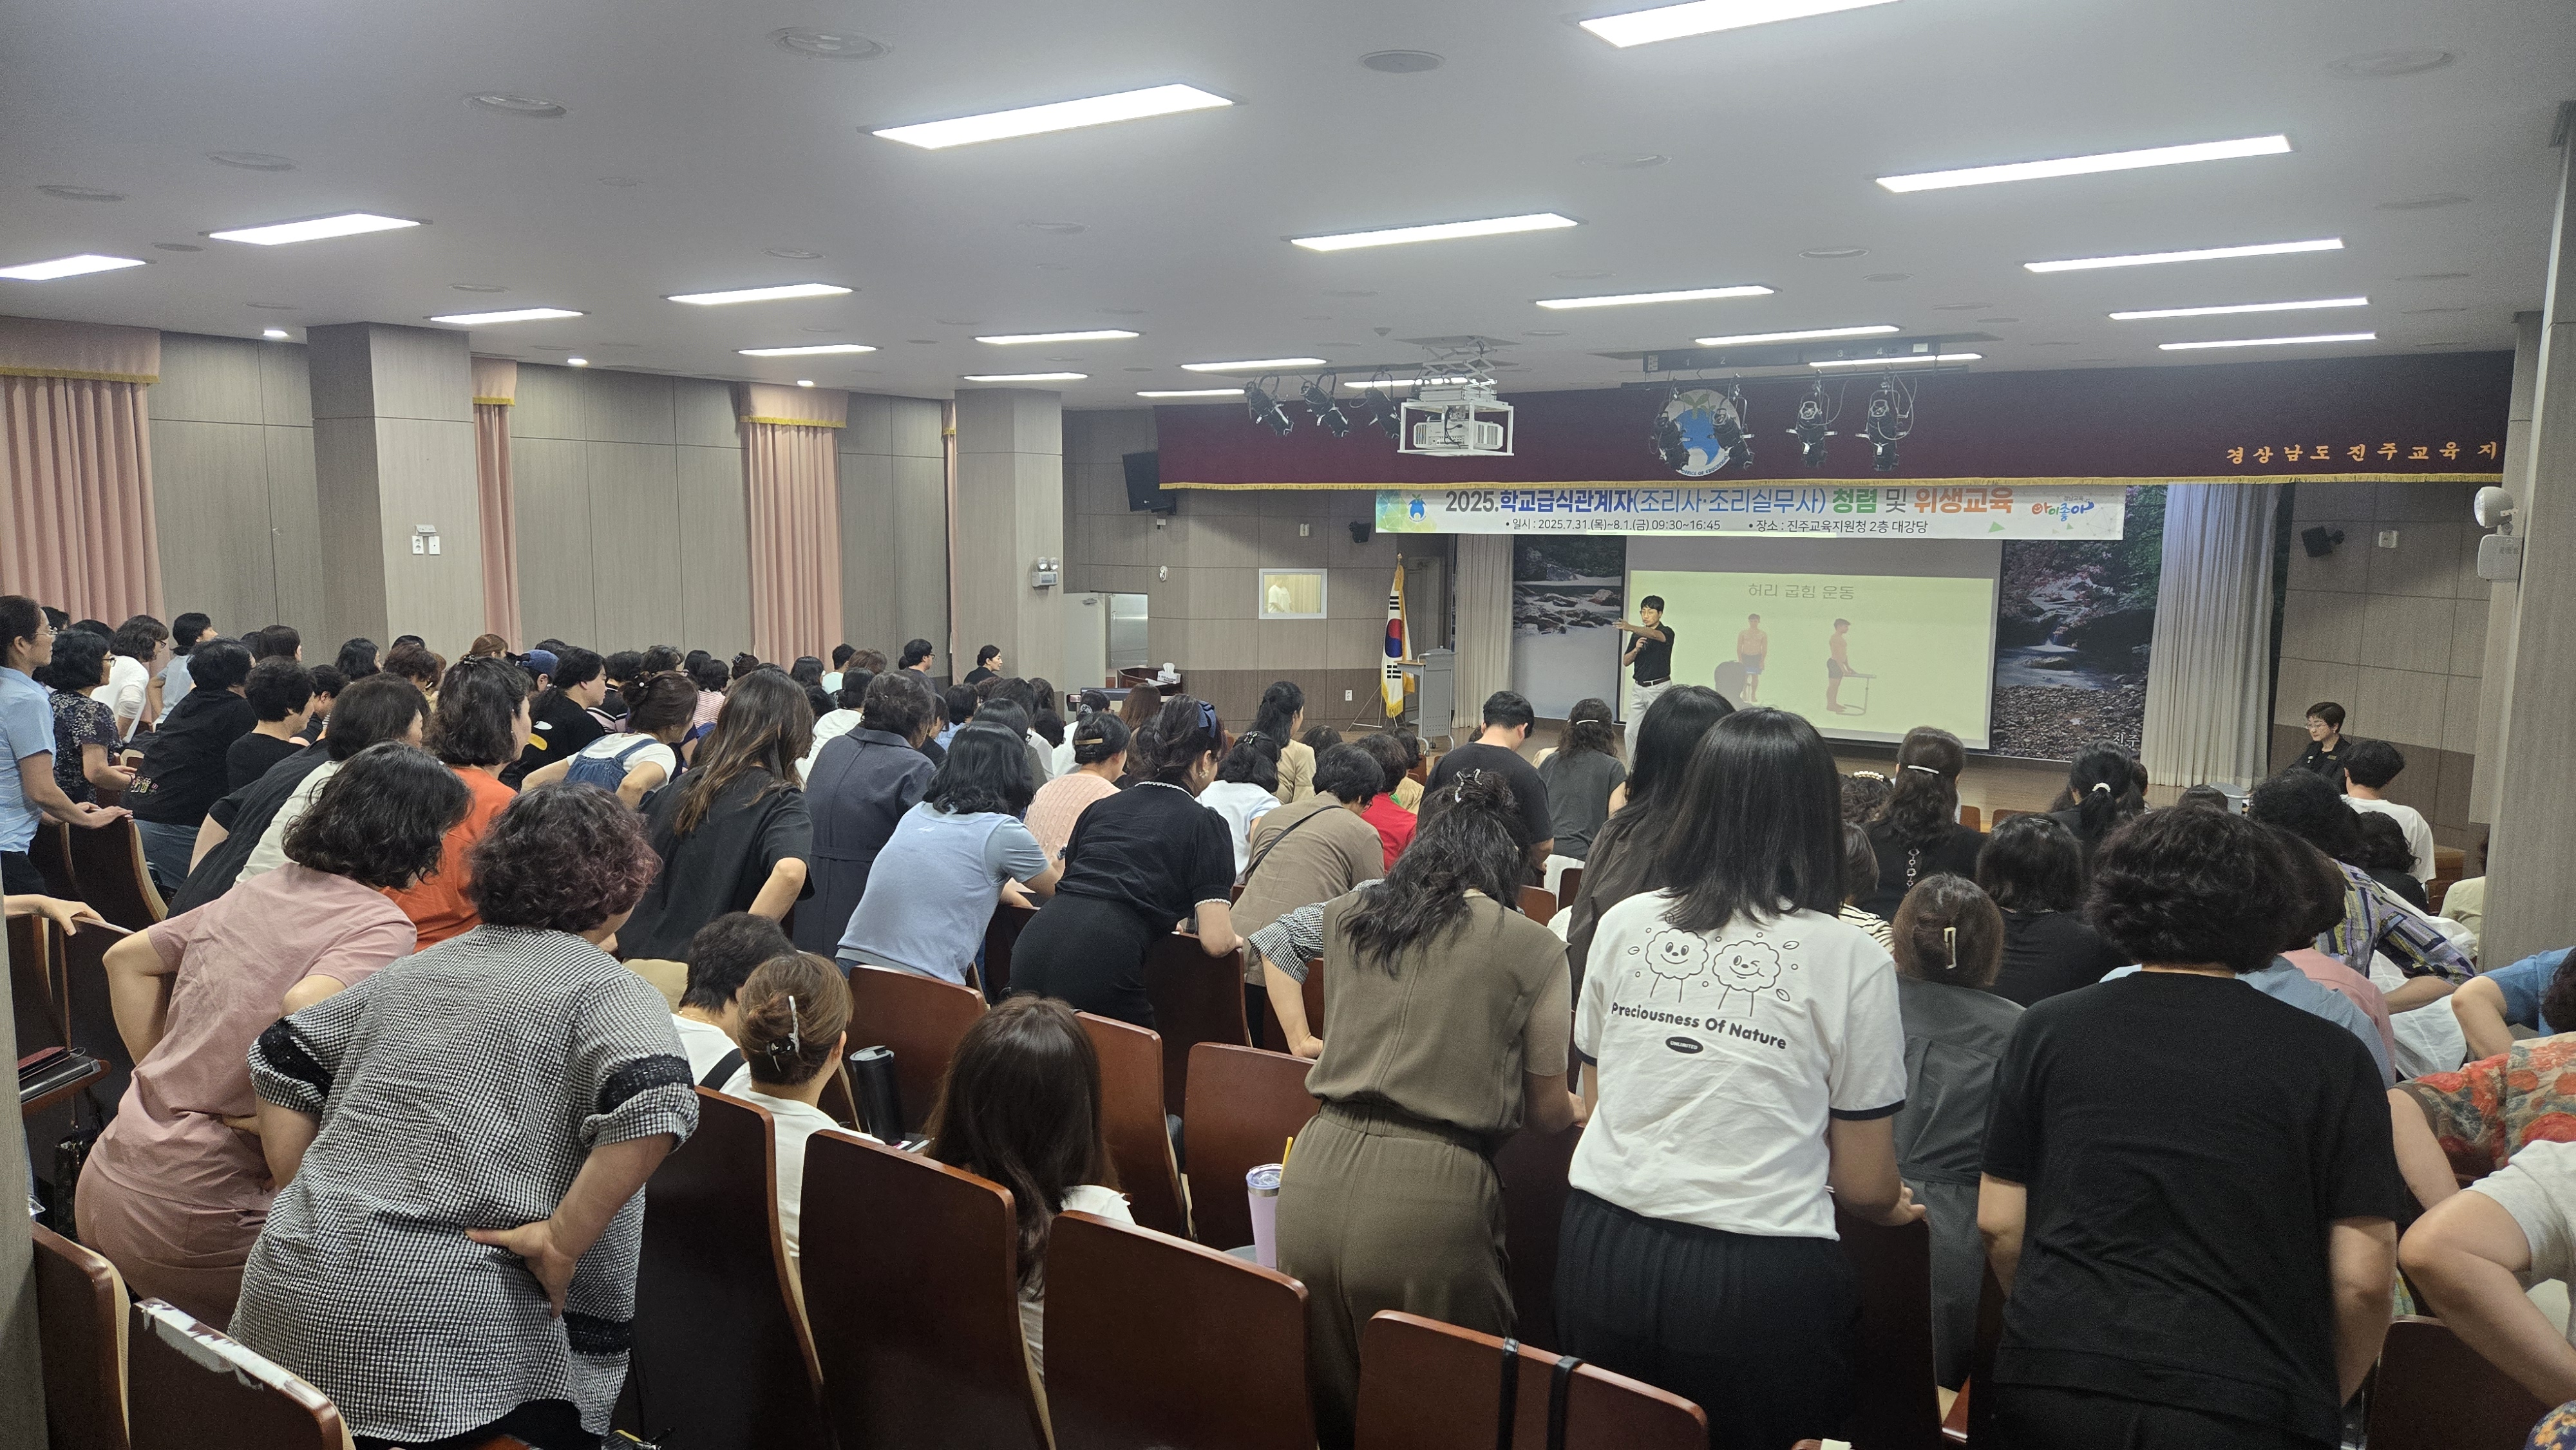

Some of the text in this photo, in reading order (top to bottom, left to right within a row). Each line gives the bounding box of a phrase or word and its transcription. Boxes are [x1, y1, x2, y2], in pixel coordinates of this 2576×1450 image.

[1837, 349, 1843, 357] 3
[1877, 347, 1883, 355] 4
[1832, 487, 1878, 514] 청렴
[1885, 487, 1906, 513] 및
[1914, 487, 2014, 514] 위생교육
[1513, 518, 1531, 530] 일시
[1538, 519, 1649, 531] 2025.7.31.(목)~8.1.(금)
[1652, 520, 1721, 530] 09:30~16:45
[1756, 520, 1779, 532] 장소
[1787, 520, 1866, 533] 진주교육지원청
[1870, 520, 1889, 534] 2층
[1891, 520, 1929, 534] 대강당
[1748, 583, 1854, 600] 허리 굽힘 운동
[1611, 1002, 1787, 1050] Preciousness Of Nature
